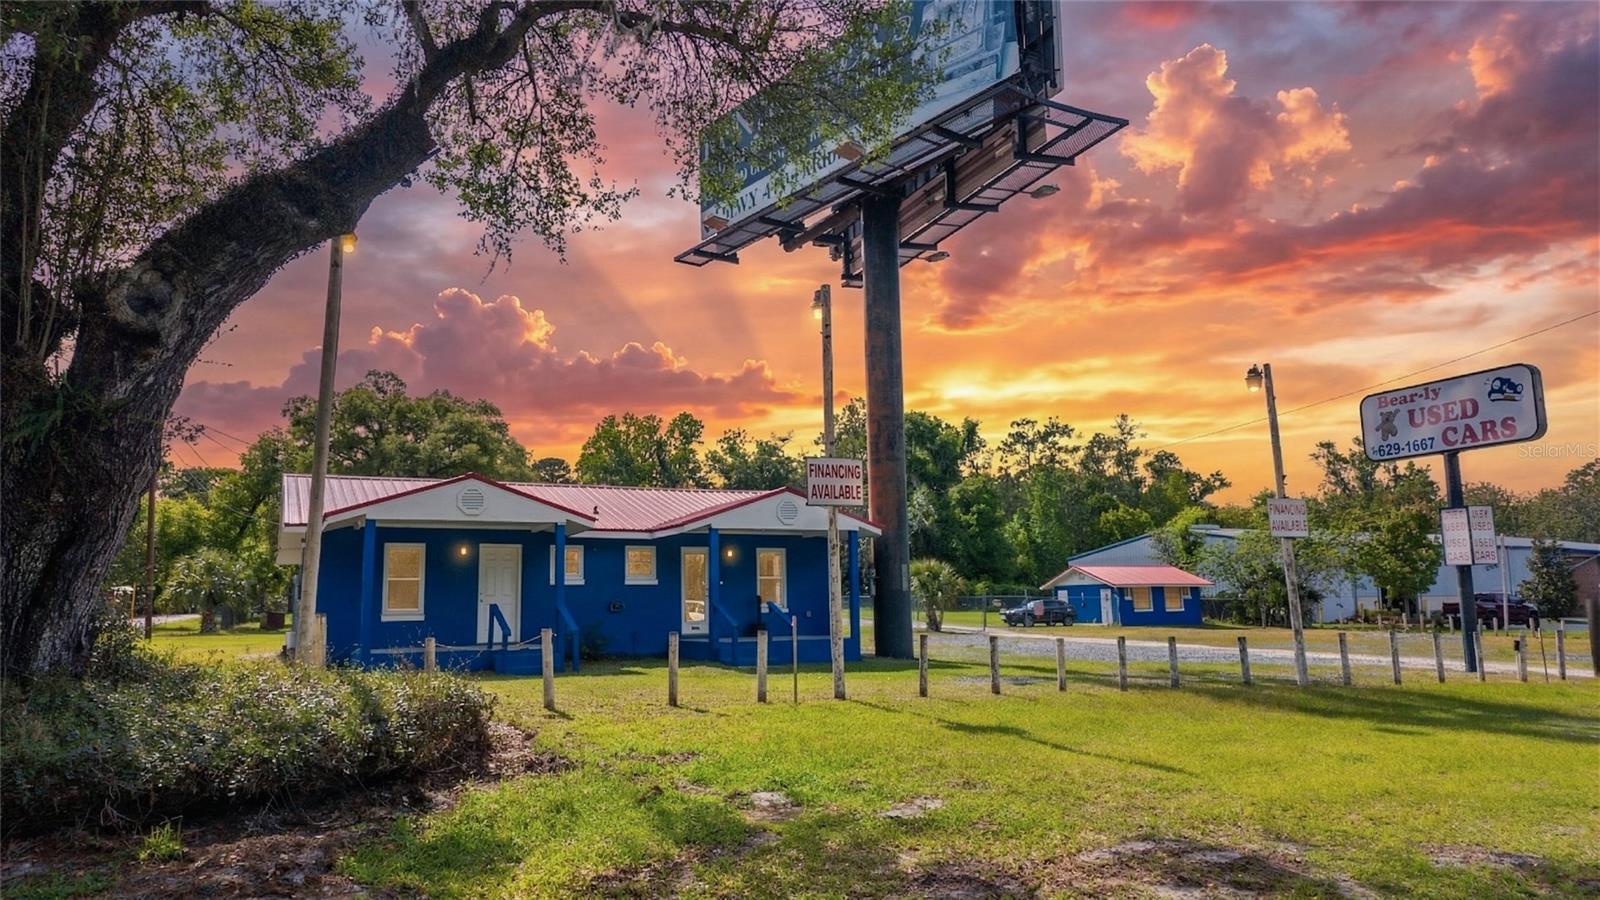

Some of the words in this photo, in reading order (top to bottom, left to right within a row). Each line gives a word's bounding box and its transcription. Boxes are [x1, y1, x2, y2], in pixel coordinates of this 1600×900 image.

[1376, 386, 1441, 409] Bear-ly
[1408, 397, 1479, 428] USED
[1441, 416, 1518, 447] CARS
[1378, 436, 1435, 457] 629-1667
[808, 463, 861, 479] FINANCING
[811, 484, 862, 500] AVAILABLE
